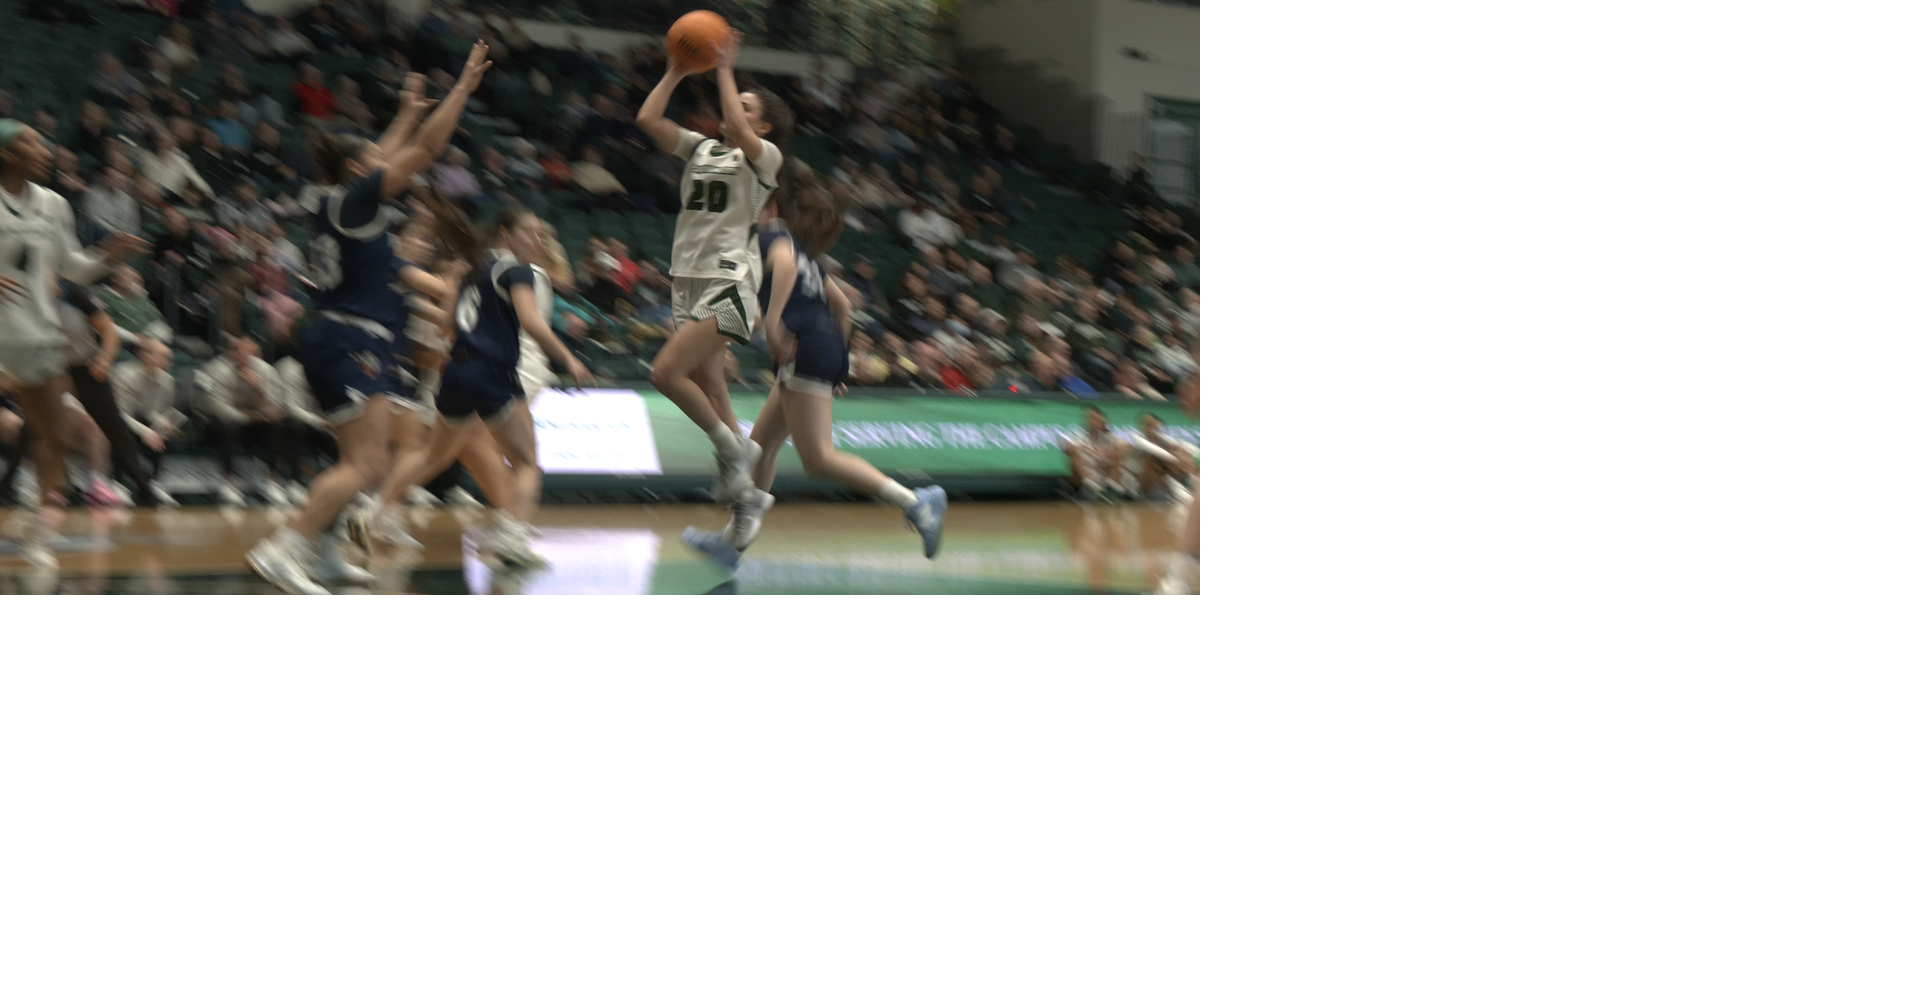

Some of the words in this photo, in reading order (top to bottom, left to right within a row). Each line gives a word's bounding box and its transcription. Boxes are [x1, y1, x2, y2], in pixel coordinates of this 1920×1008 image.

[686, 179, 728, 213] 20
[836, 420, 941, 449] SERVING
[936, 421, 989, 449] THE
